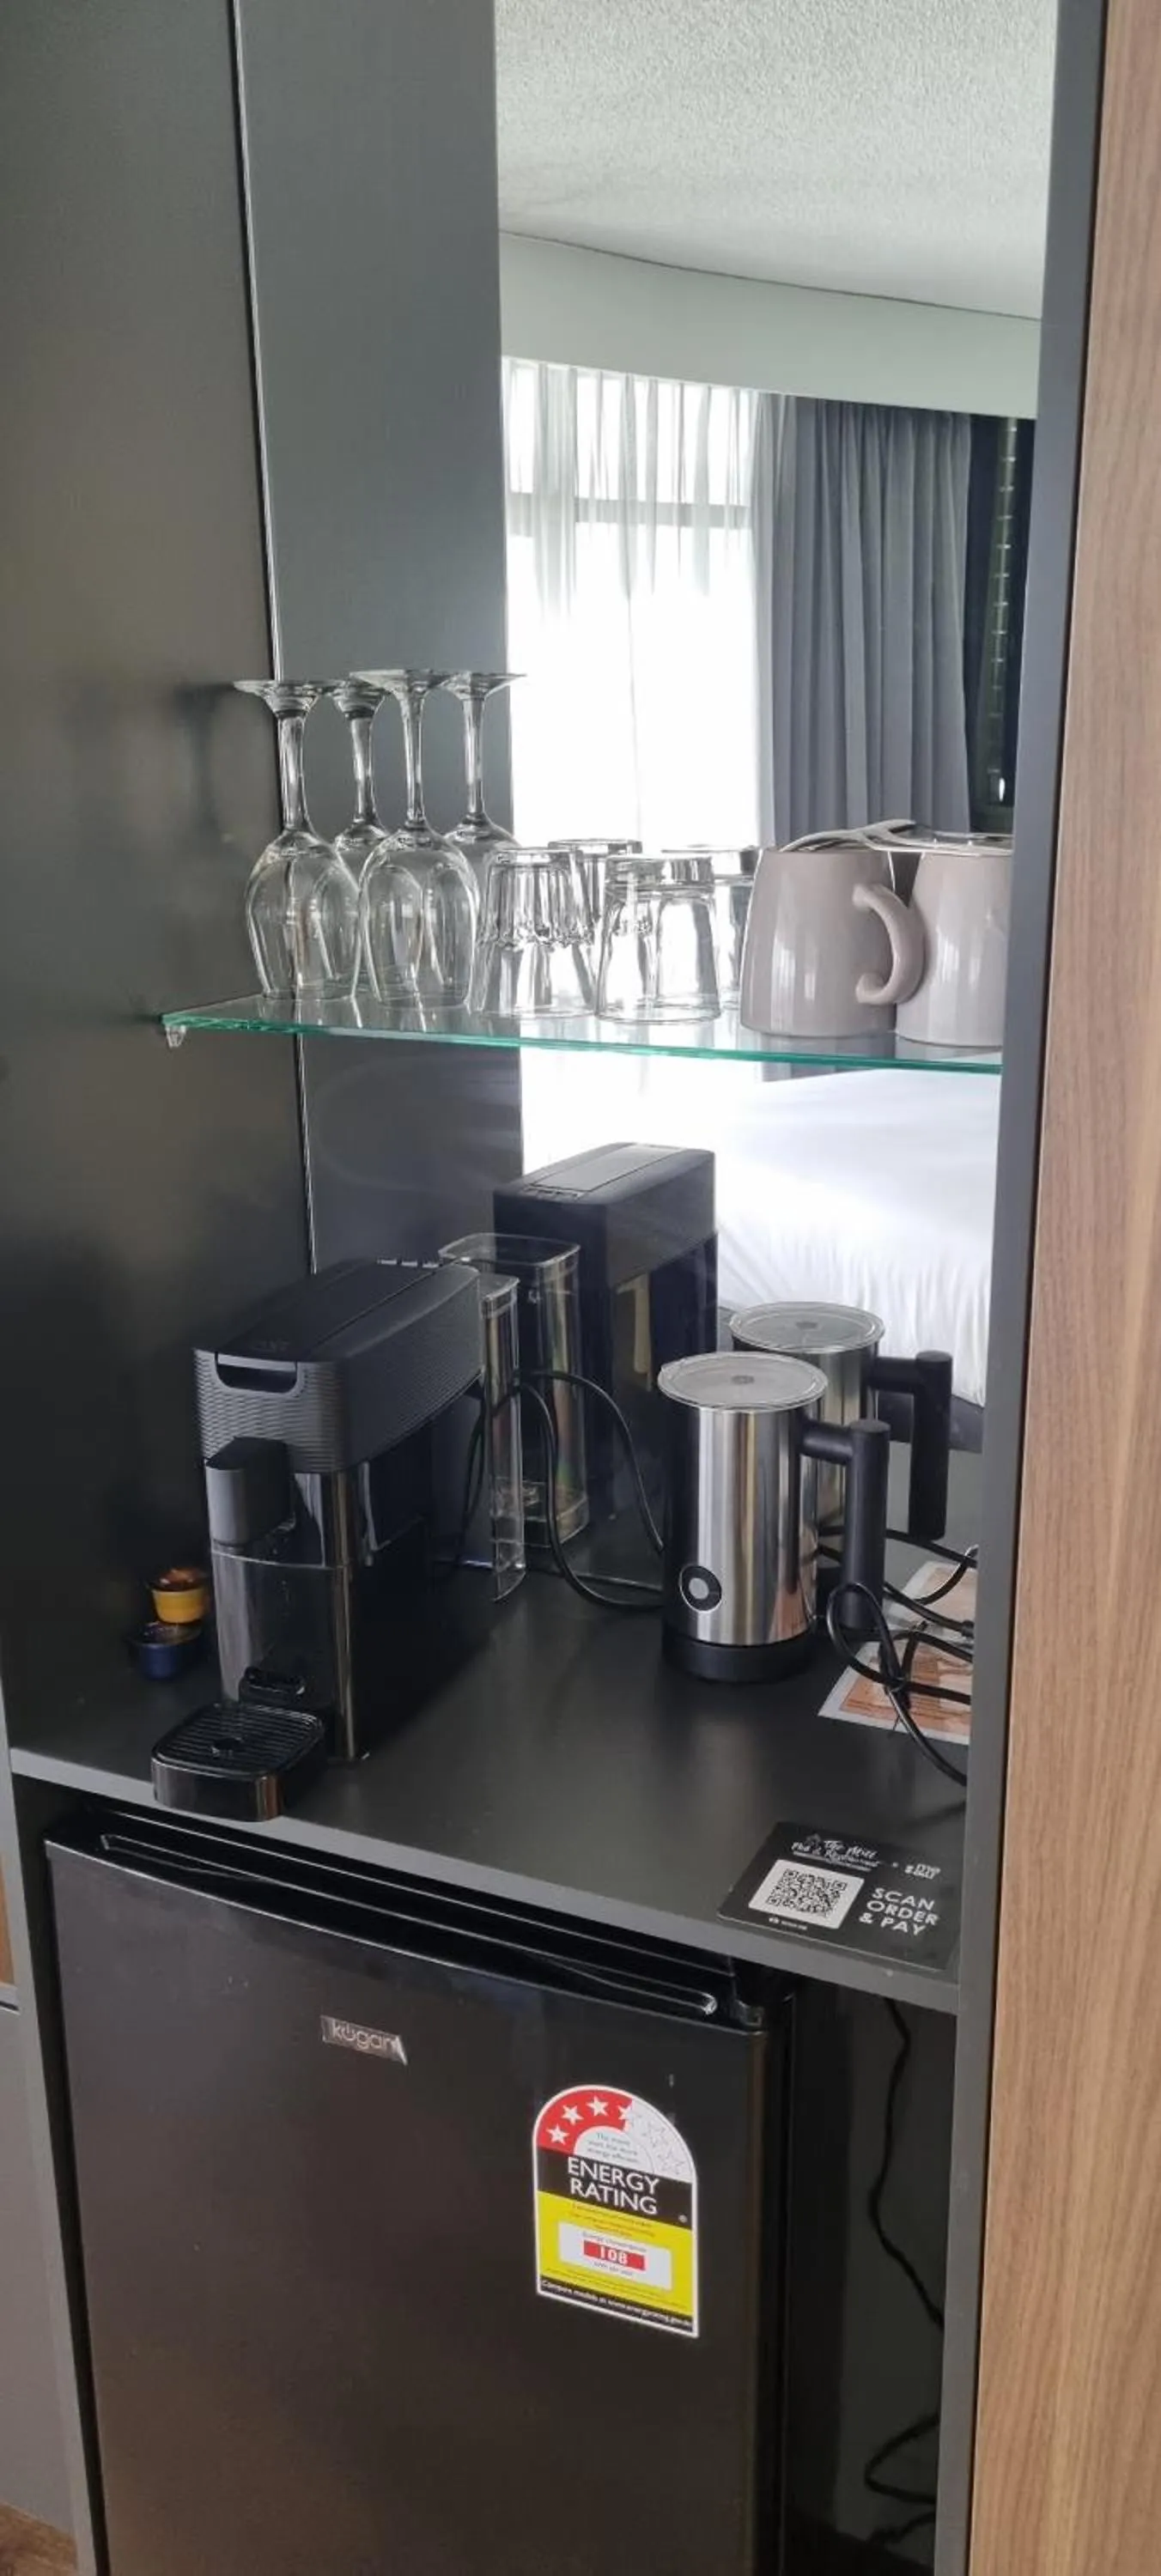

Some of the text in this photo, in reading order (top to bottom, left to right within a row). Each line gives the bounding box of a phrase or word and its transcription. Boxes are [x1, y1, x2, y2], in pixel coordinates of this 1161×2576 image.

[872, 1888, 935, 1911] SCAN
[860, 1912, 927, 1935] & PAY
[866, 1900, 939, 1926] ORDER
[568, 2156, 660, 2195] ENERGY
[570, 2180, 658, 2215] RATING
[600, 2246, 629, 2266] 108
